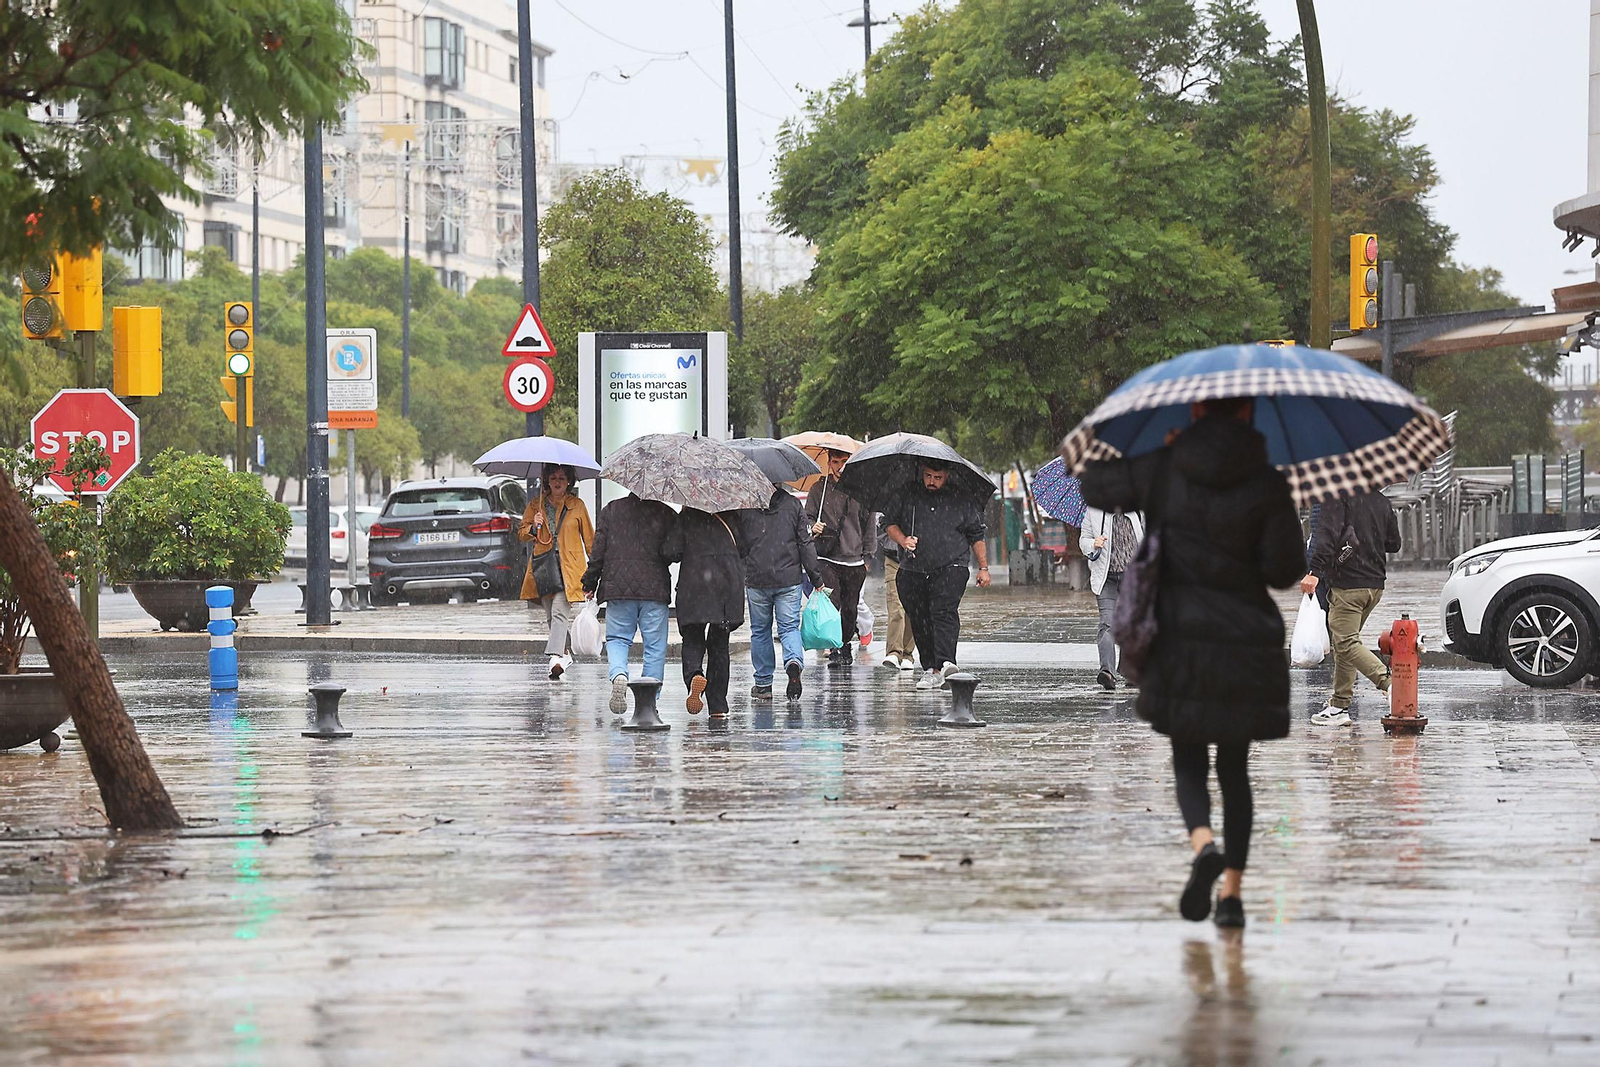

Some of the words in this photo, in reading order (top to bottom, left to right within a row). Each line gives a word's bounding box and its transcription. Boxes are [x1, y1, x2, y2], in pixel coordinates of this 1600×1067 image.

[518, 376, 540, 394] 30
[626, 380, 642, 389] las
[610, 391, 632, 402] que
[634, 391, 646, 400] te
[649, 391, 688, 402] gustan
[40, 430, 130, 454] STOP
[420, 534, 440, 542] 6166
[443, 532, 457, 541] LFF
